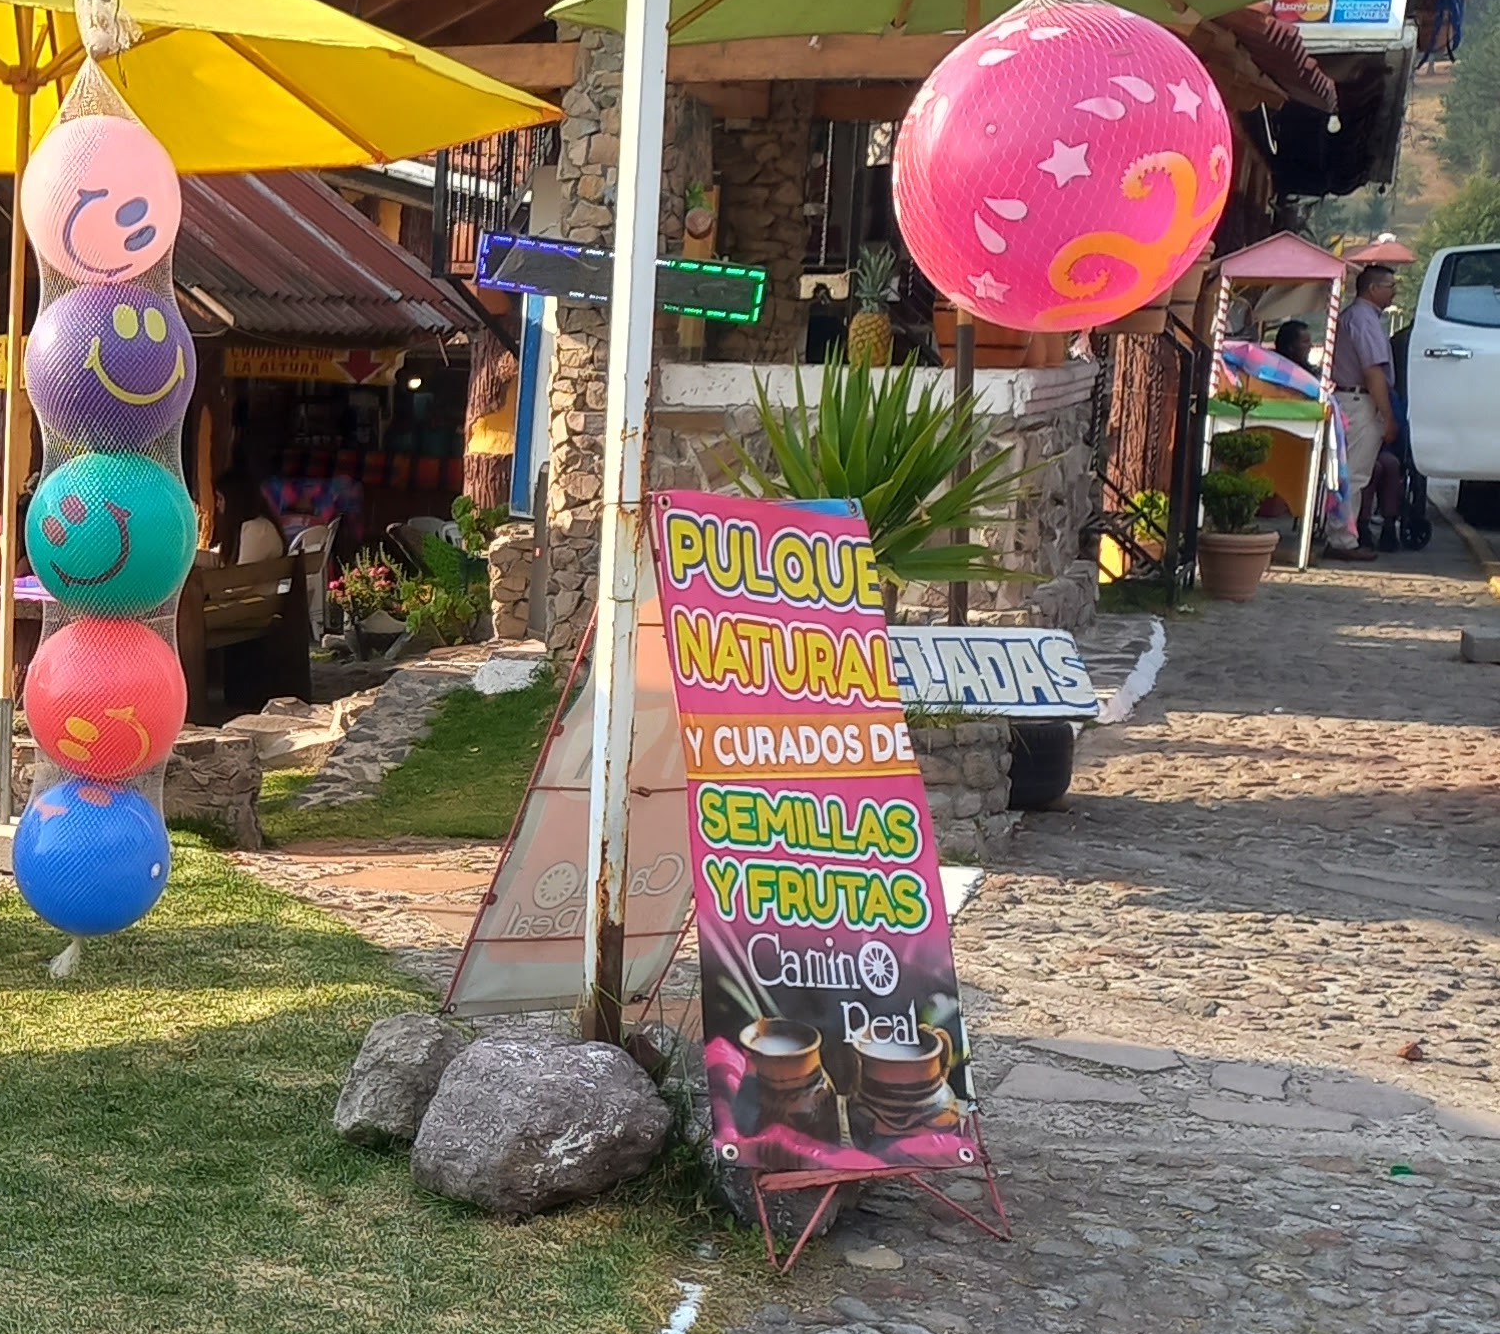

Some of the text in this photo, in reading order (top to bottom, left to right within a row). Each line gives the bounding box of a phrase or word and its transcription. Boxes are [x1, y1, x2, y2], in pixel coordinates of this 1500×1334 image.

[233, 360, 320, 376] LA ALTURA
[667, 512, 884, 609] PULQUE
[673, 610, 902, 703] NATURAL
[889, 636, 1099, 708] ELADAS
[684, 722, 915, 767] Y CURADOS DE
[698, 786, 920, 859] SEMILLAS
[705, 857, 928, 929] Y FRUTAS
[840, 999, 921, 1047] Real
